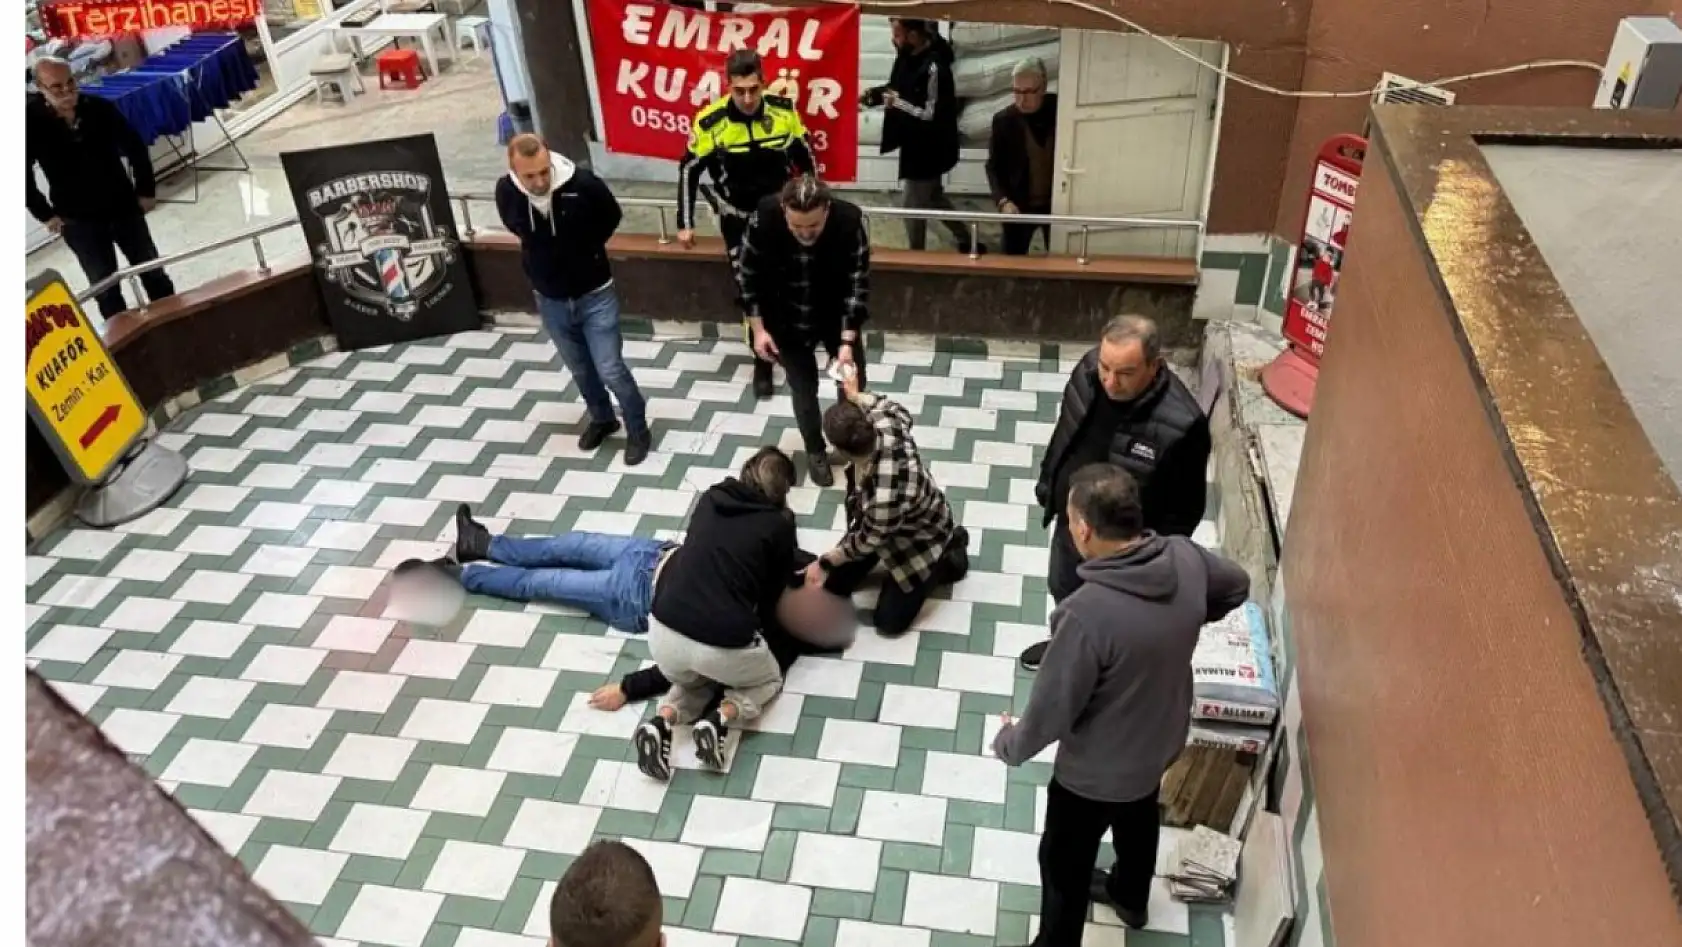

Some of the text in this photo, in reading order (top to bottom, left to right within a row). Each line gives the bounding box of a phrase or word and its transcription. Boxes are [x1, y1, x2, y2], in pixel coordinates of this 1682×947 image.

[622, 3, 824, 60] EMRAL
[616, 58, 842, 120] KUAÖR
[631, 104, 690, 135] 0538
[308, 173, 430, 208] BARBERSHOP
[35, 336, 88, 391] KUAFÖR
[52, 386, 84, 422] Zemin
[86, 362, 109, 385] Kat
